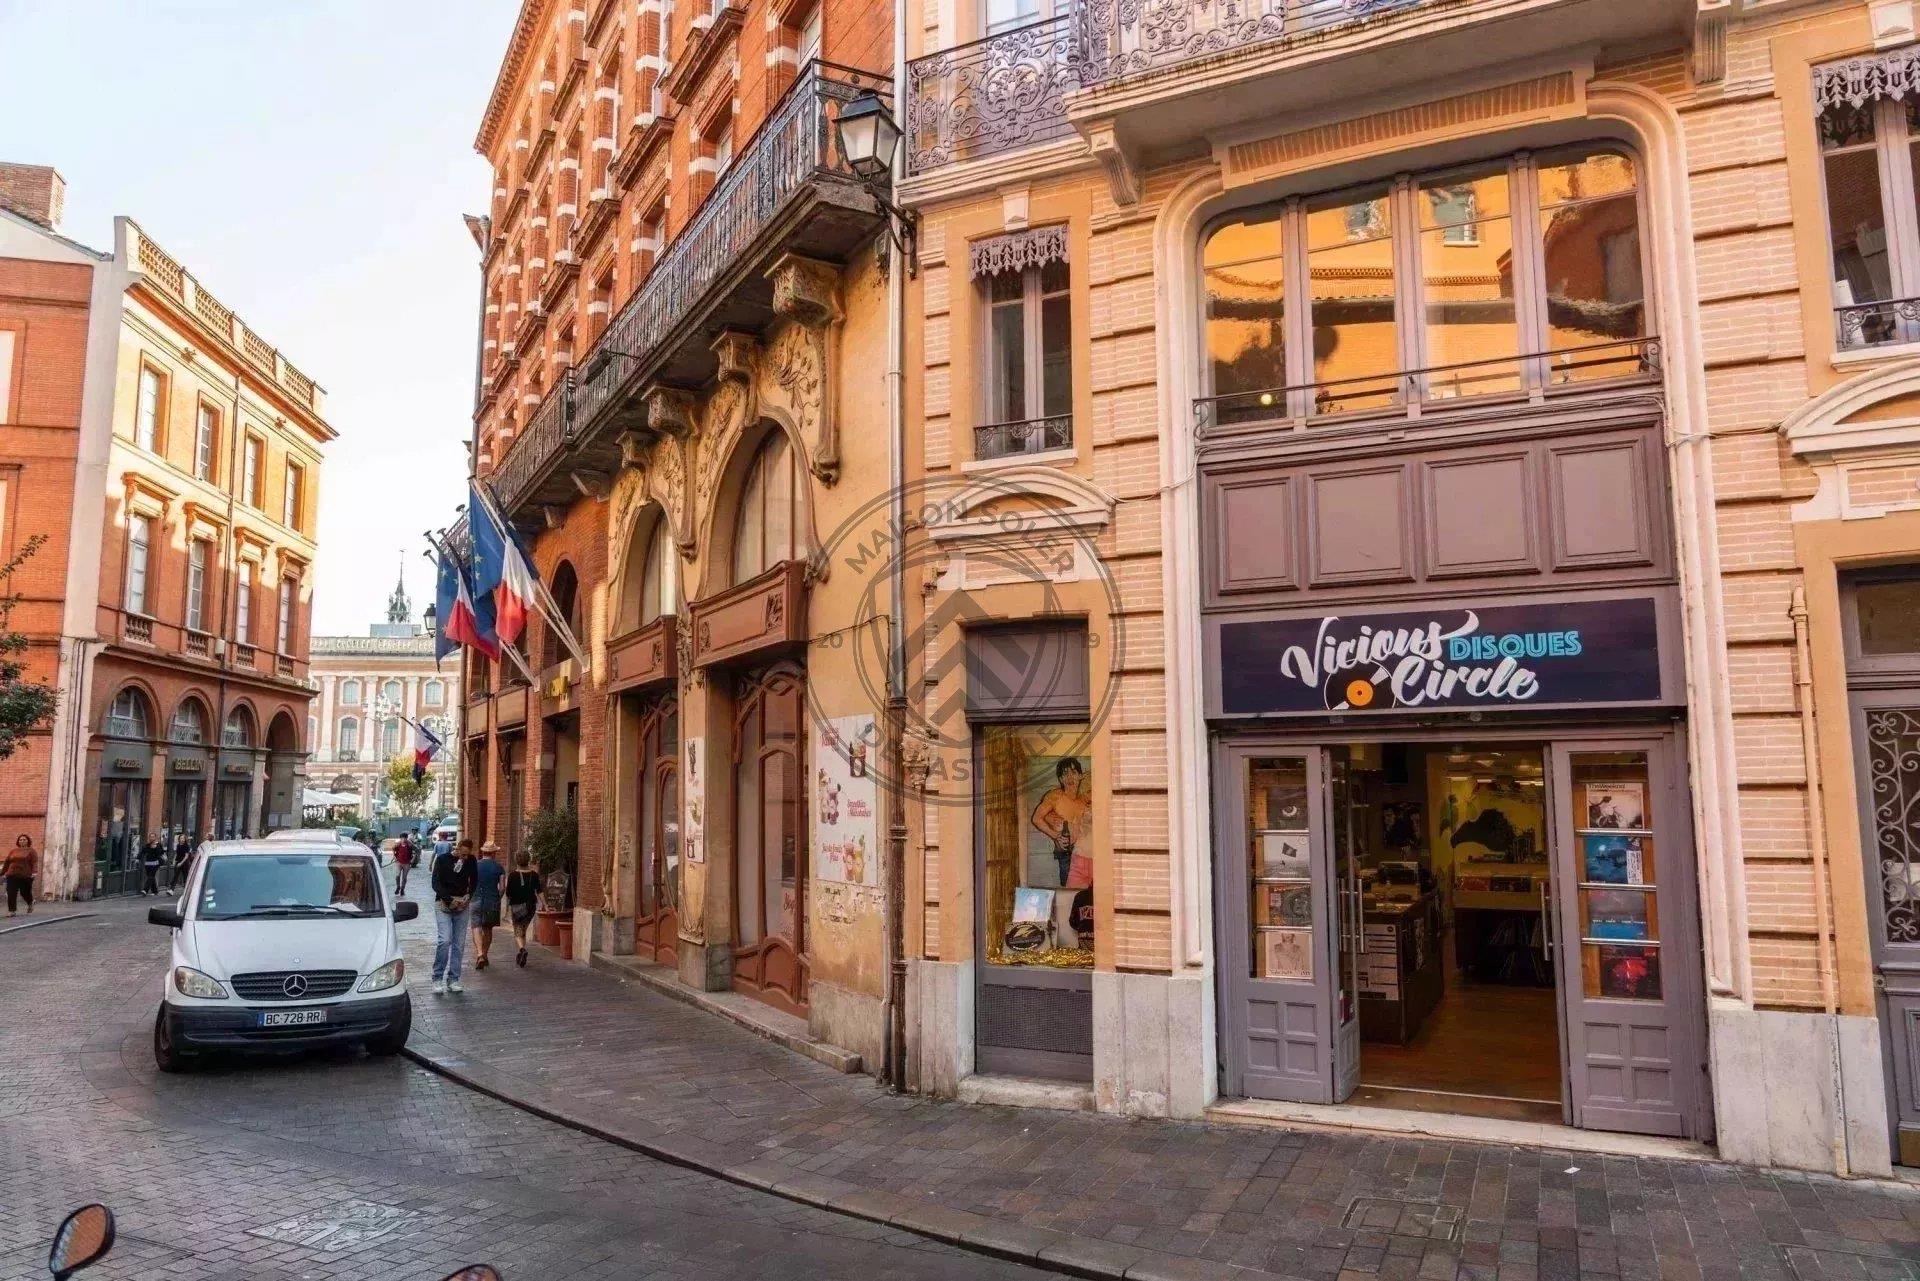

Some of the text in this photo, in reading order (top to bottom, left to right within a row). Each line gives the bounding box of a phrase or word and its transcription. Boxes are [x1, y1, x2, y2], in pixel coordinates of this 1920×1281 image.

[1280, 609, 1479, 688] Vicious
[1449, 631, 1582, 661] DISQUES
[1390, 656, 1539, 706] Circle
